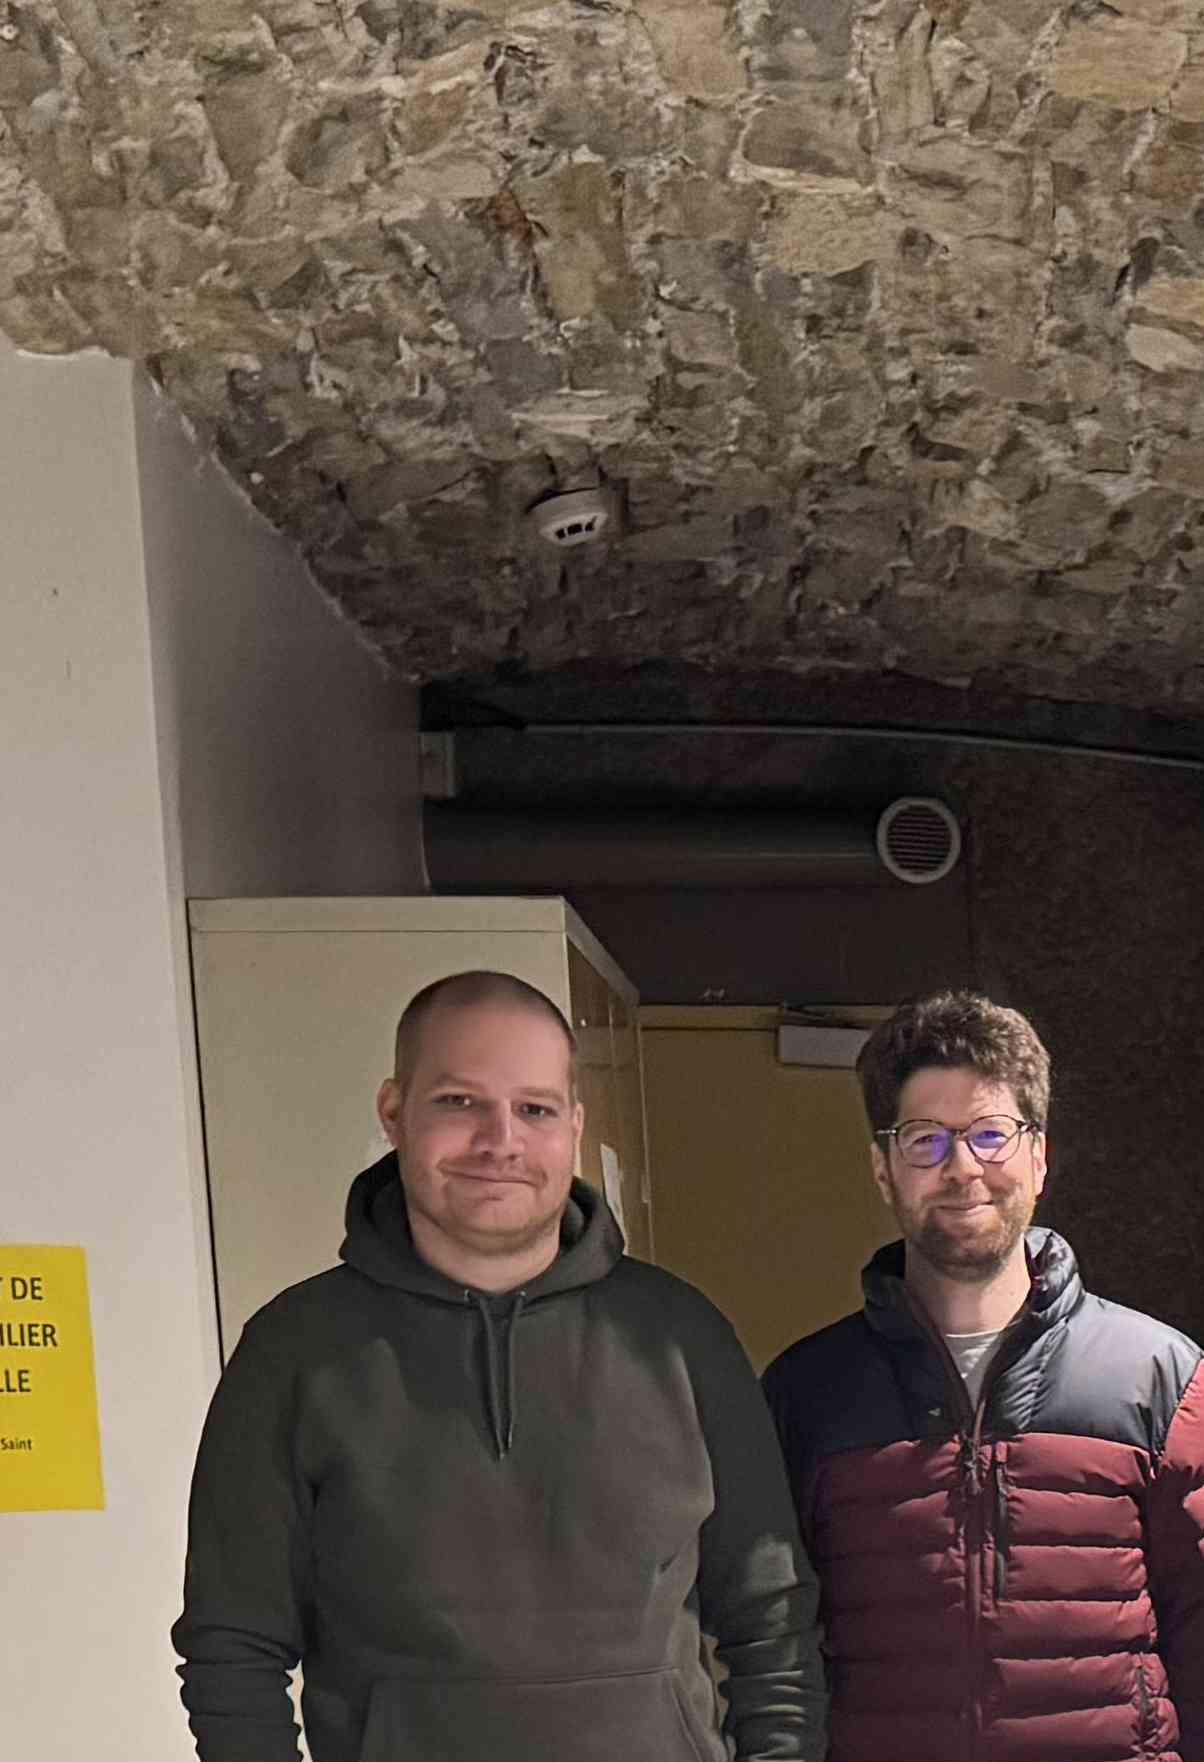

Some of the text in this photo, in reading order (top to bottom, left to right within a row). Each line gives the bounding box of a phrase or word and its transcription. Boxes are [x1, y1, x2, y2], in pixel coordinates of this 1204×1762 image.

[11, 1277, 43, 1300] DE
[0, 1323, 58, 1346] ILIER
[1, 1438, 32, 1451] Saint
